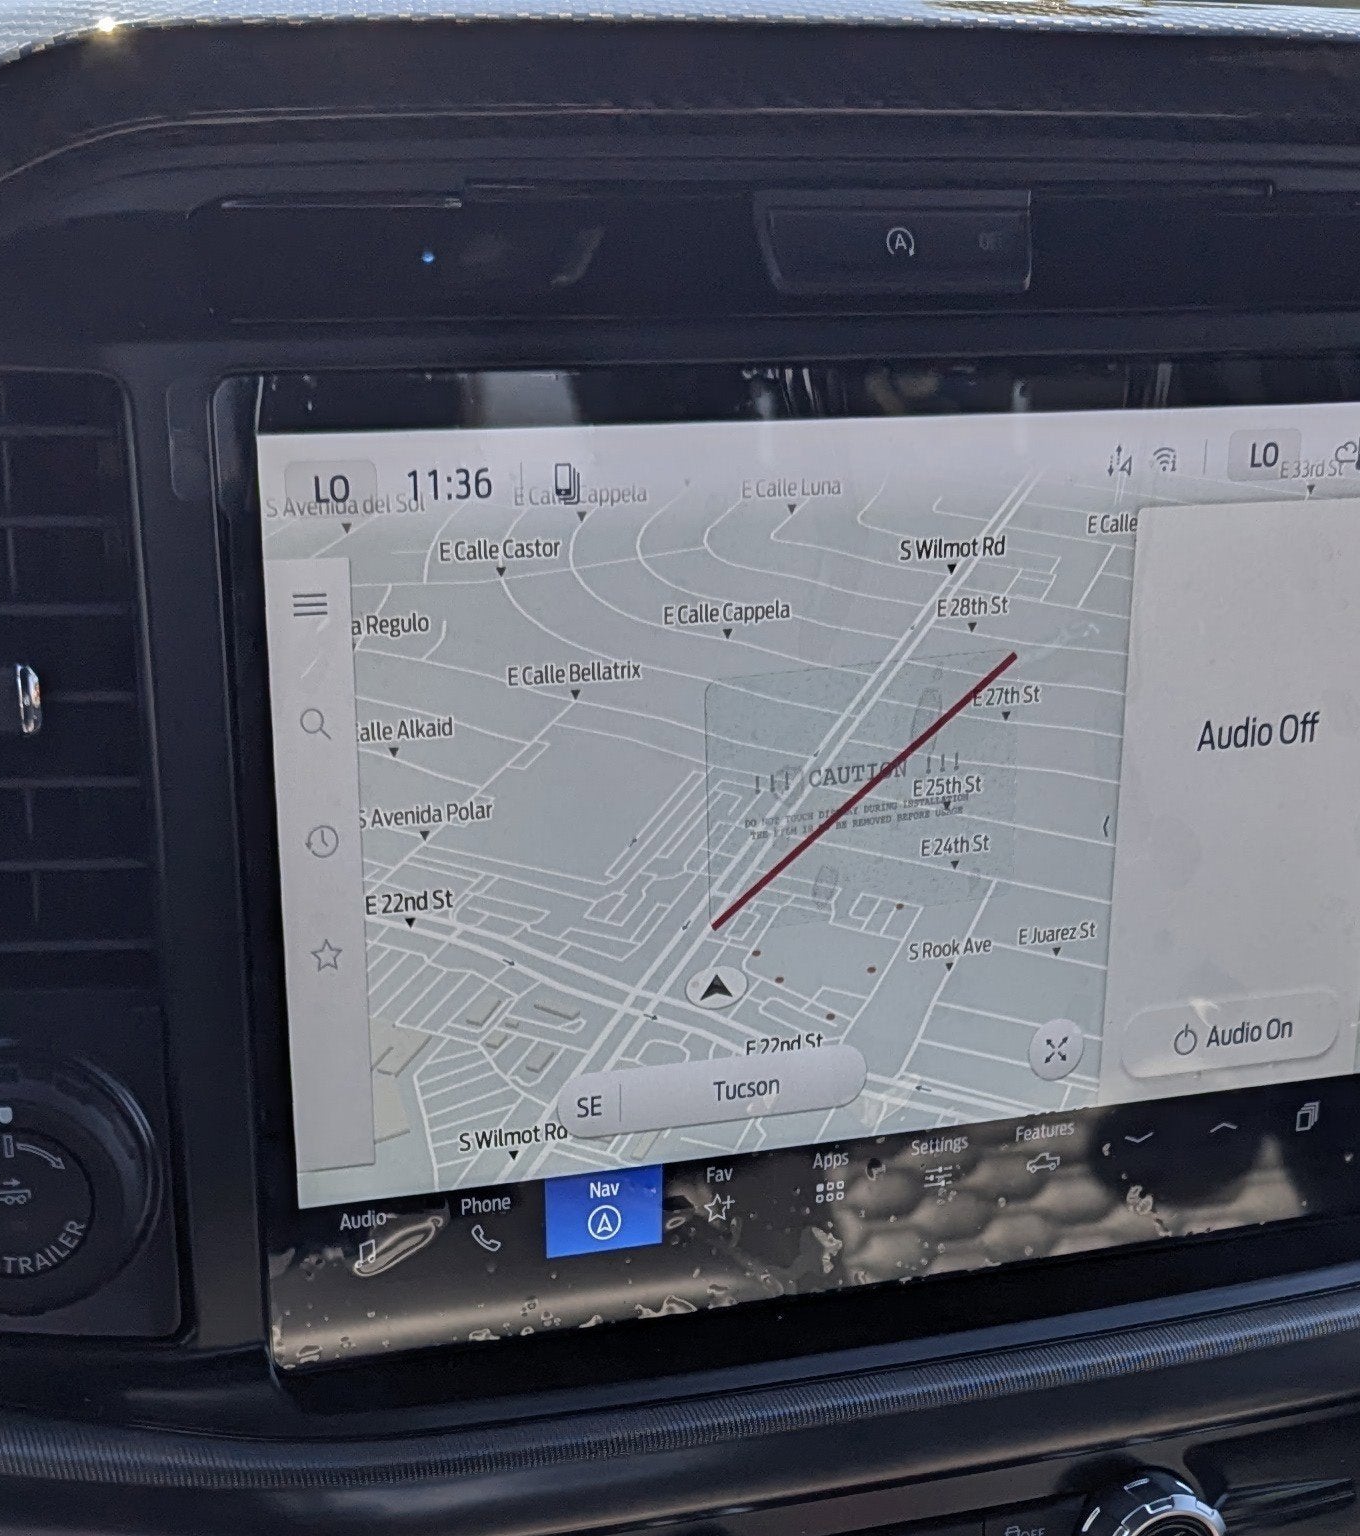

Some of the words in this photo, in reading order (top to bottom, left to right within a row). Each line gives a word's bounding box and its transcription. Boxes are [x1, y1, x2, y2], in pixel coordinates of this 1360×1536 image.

[1249, 441, 1280, 469] LO
[313, 474, 350, 504] LO
[407, 466, 493, 501] 11:36
[742, 479, 752, 498] E
[755, 478, 798, 498] Calle
[801, 477, 841, 497] Luna
[266, 500, 278, 518] S
[363, 495, 391, 515] del
[396, 492, 425, 514] Sol
[1087, 516, 1098, 535] E
[1100, 513, 1138, 534] Calle
[440, 543, 451, 561] E
[454, 540, 499, 561] Calle
[502, 537, 561, 559] Castor
[900, 541, 912, 561] S
[915, 537, 979, 560] Wilmot
[982, 535, 1006, 557] Rd
[664, 607, 674, 625] E
[677, 604, 720, 624] Calle
[723, 601, 791, 624] Cappela
[937, 599, 948, 617] E
[949, 598, 988, 617] 28th
[991, 596, 1009, 614] St
[366, 612, 429, 637] Regulo
[508, 666, 519, 686] E
[522, 664, 566, 686] Calle
[569, 660, 641, 683] Bellatrix
[973, 690, 983, 707] E
[986, 688, 1021, 707] 27th
[1023, 686, 1041, 703] St
[356, 721, 393, 742] alle
[397, 716, 453, 739] Alkaid
[1197, 717, 1273, 752] Audio
[1279, 711, 1321, 746] Off
[914, 780, 923, 798] E
[925, 777, 961, 797] 25th
[965, 775, 982, 793] St
[371, 805, 443, 828] Avenida
[446, 801, 494, 823] Polar
[921, 838, 931, 857] E
[933, 835, 969, 856] 24th
[973, 834, 990, 852] St
[365, 896, 377, 915] E
[381, 891, 428, 914] 22nd
[432, 889, 453, 910] St
[1019, 927, 1028, 945] E
[1031, 924, 1077, 944] Juarez
[1080, 922, 1097, 940] St
[909, 943, 919, 961] S
[922, 939, 960, 960] Rook
[963, 937, 992, 956] Ave
[1206, 1020, 1262, 1048] Audio
[1266, 1017, 1294, 1041] On
[713, 1077, 780, 1102] Tucson
[576, 1096, 603, 1118] SE
[459, 1132, 471, 1152] S
[474, 1127, 540, 1151] Wilmot
[1015, 1121, 1075, 1142] Features
[911, 1133, 969, 1157] Settings
[812, 1150, 850, 1171] Apps
[706, 1166, 733, 1184] Fav
[589, 1180, 620, 1199] Nav
[461, 1195, 512, 1216] Phone
[340, 1209, 387, 1231] Audio
[3, 1219, 87, 1274] TRAILER
